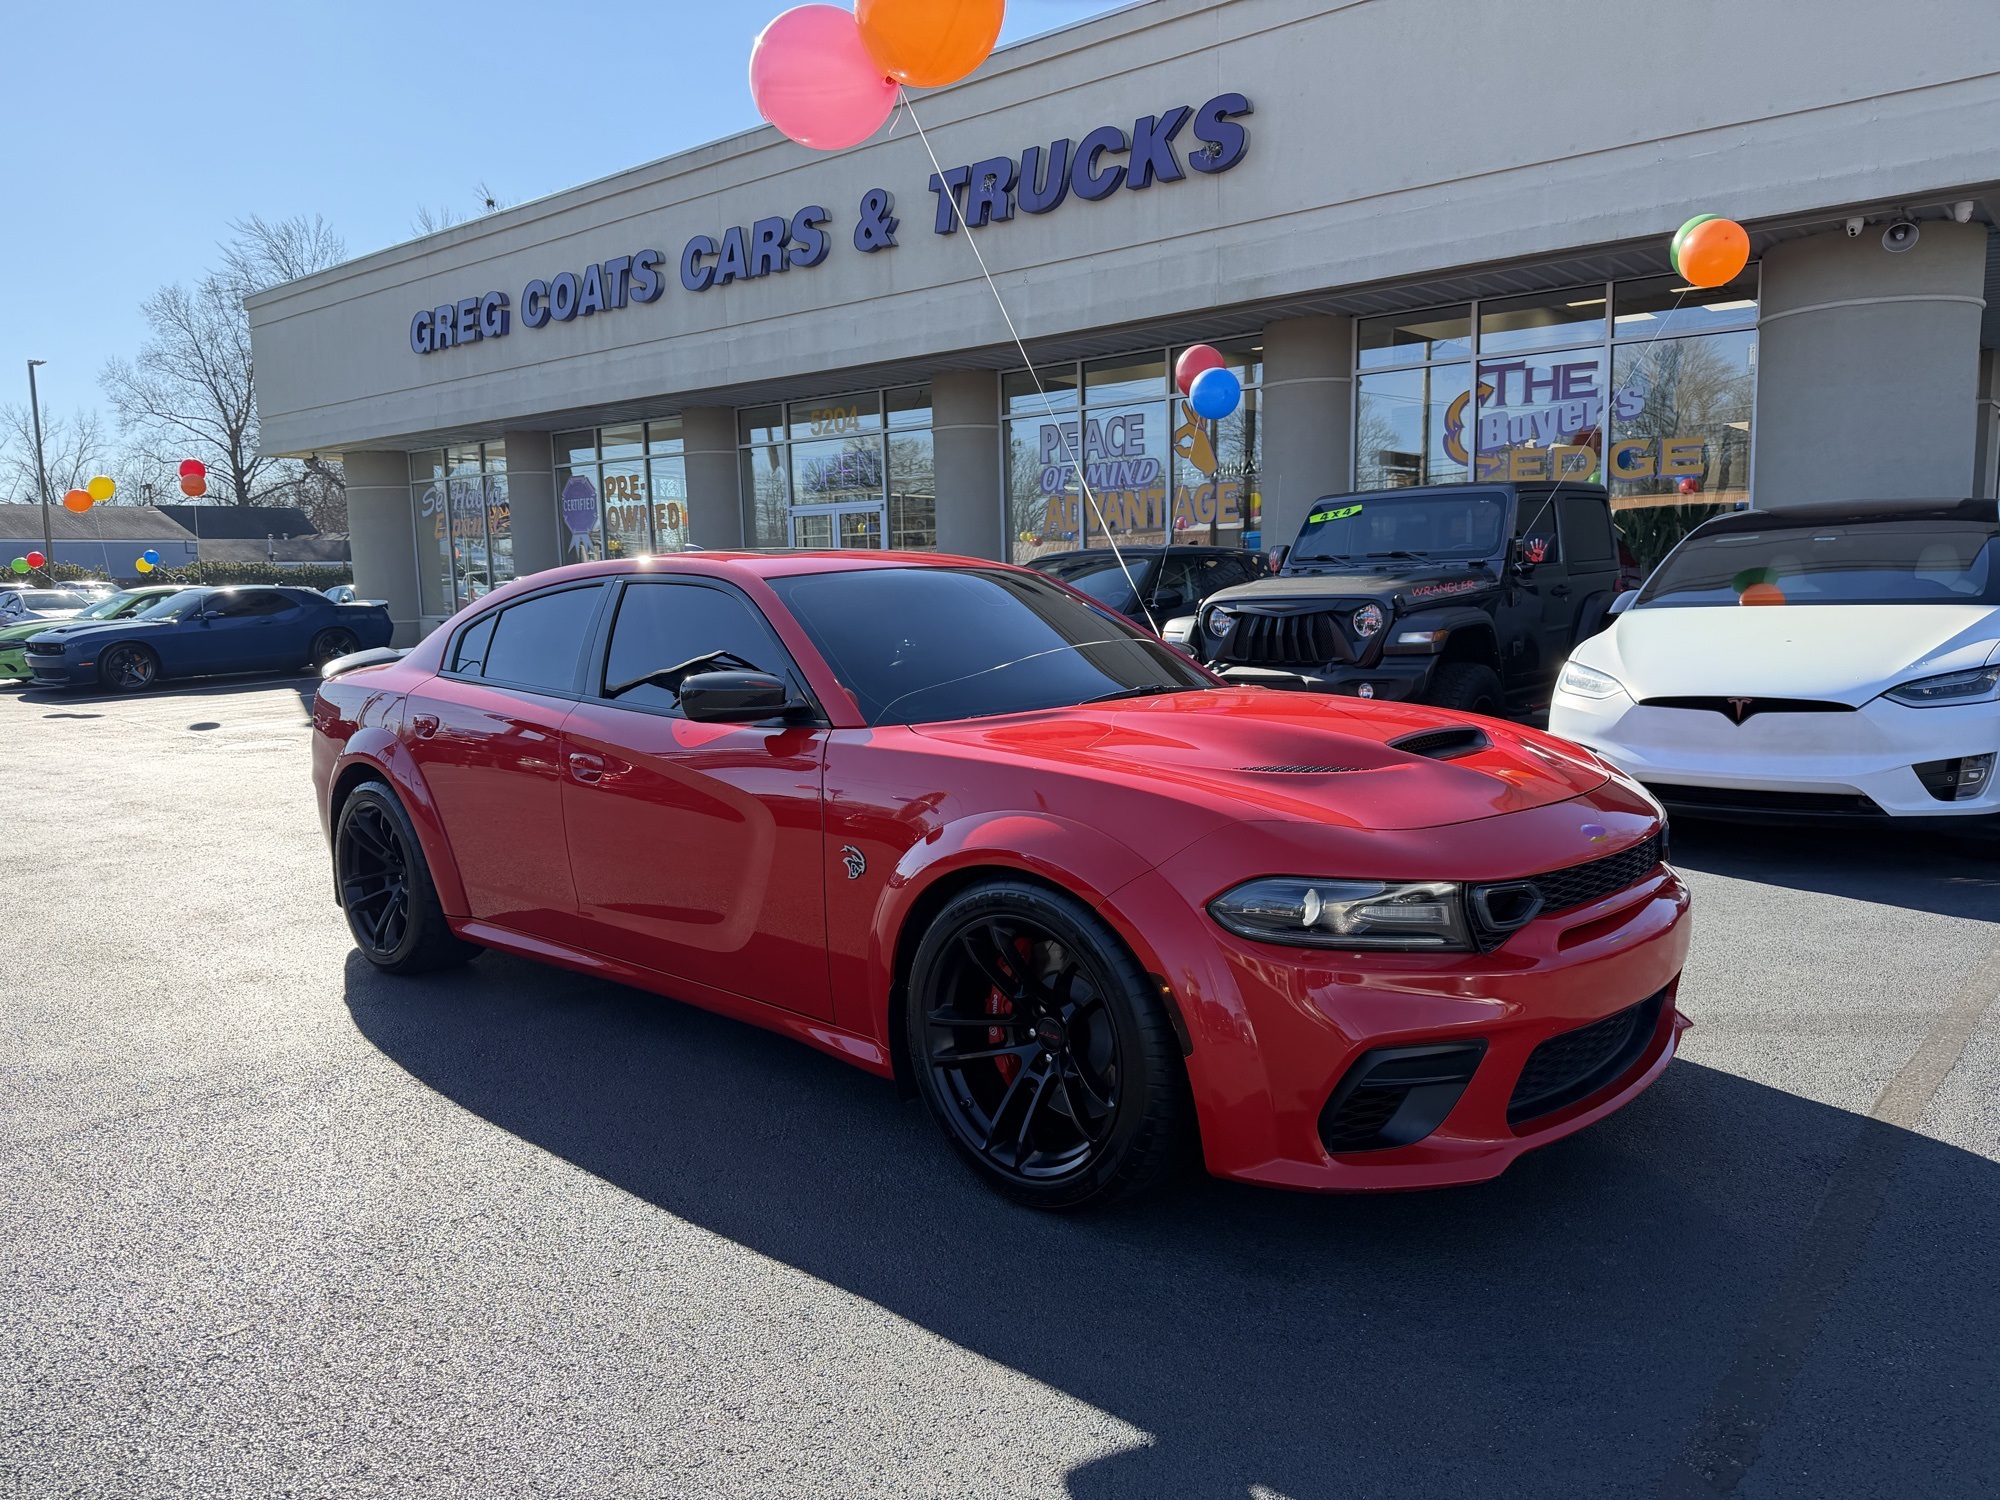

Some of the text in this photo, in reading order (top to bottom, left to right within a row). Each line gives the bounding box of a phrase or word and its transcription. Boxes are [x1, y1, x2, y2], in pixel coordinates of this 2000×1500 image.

[410, 92, 1254, 355] GREG COATS CARS & TRUCKS
[1478, 358, 1599, 408] THE
[810, 405, 860, 436] 5204
[1039, 413, 1146, 464] PEACE
[802, 451, 876, 492] OPEN
[1041, 456, 1160, 494] OF MIND
[1508, 437, 1705, 483] EDGE
[422, 477, 503, 517] Se Habla
[563, 497, 595, 512] CERTIFIED
[607, 502, 680, 532] OWNED
[1043, 482, 1241, 536] ADVANTAGE
[1411, 579, 1477, 597] WRANGLER
